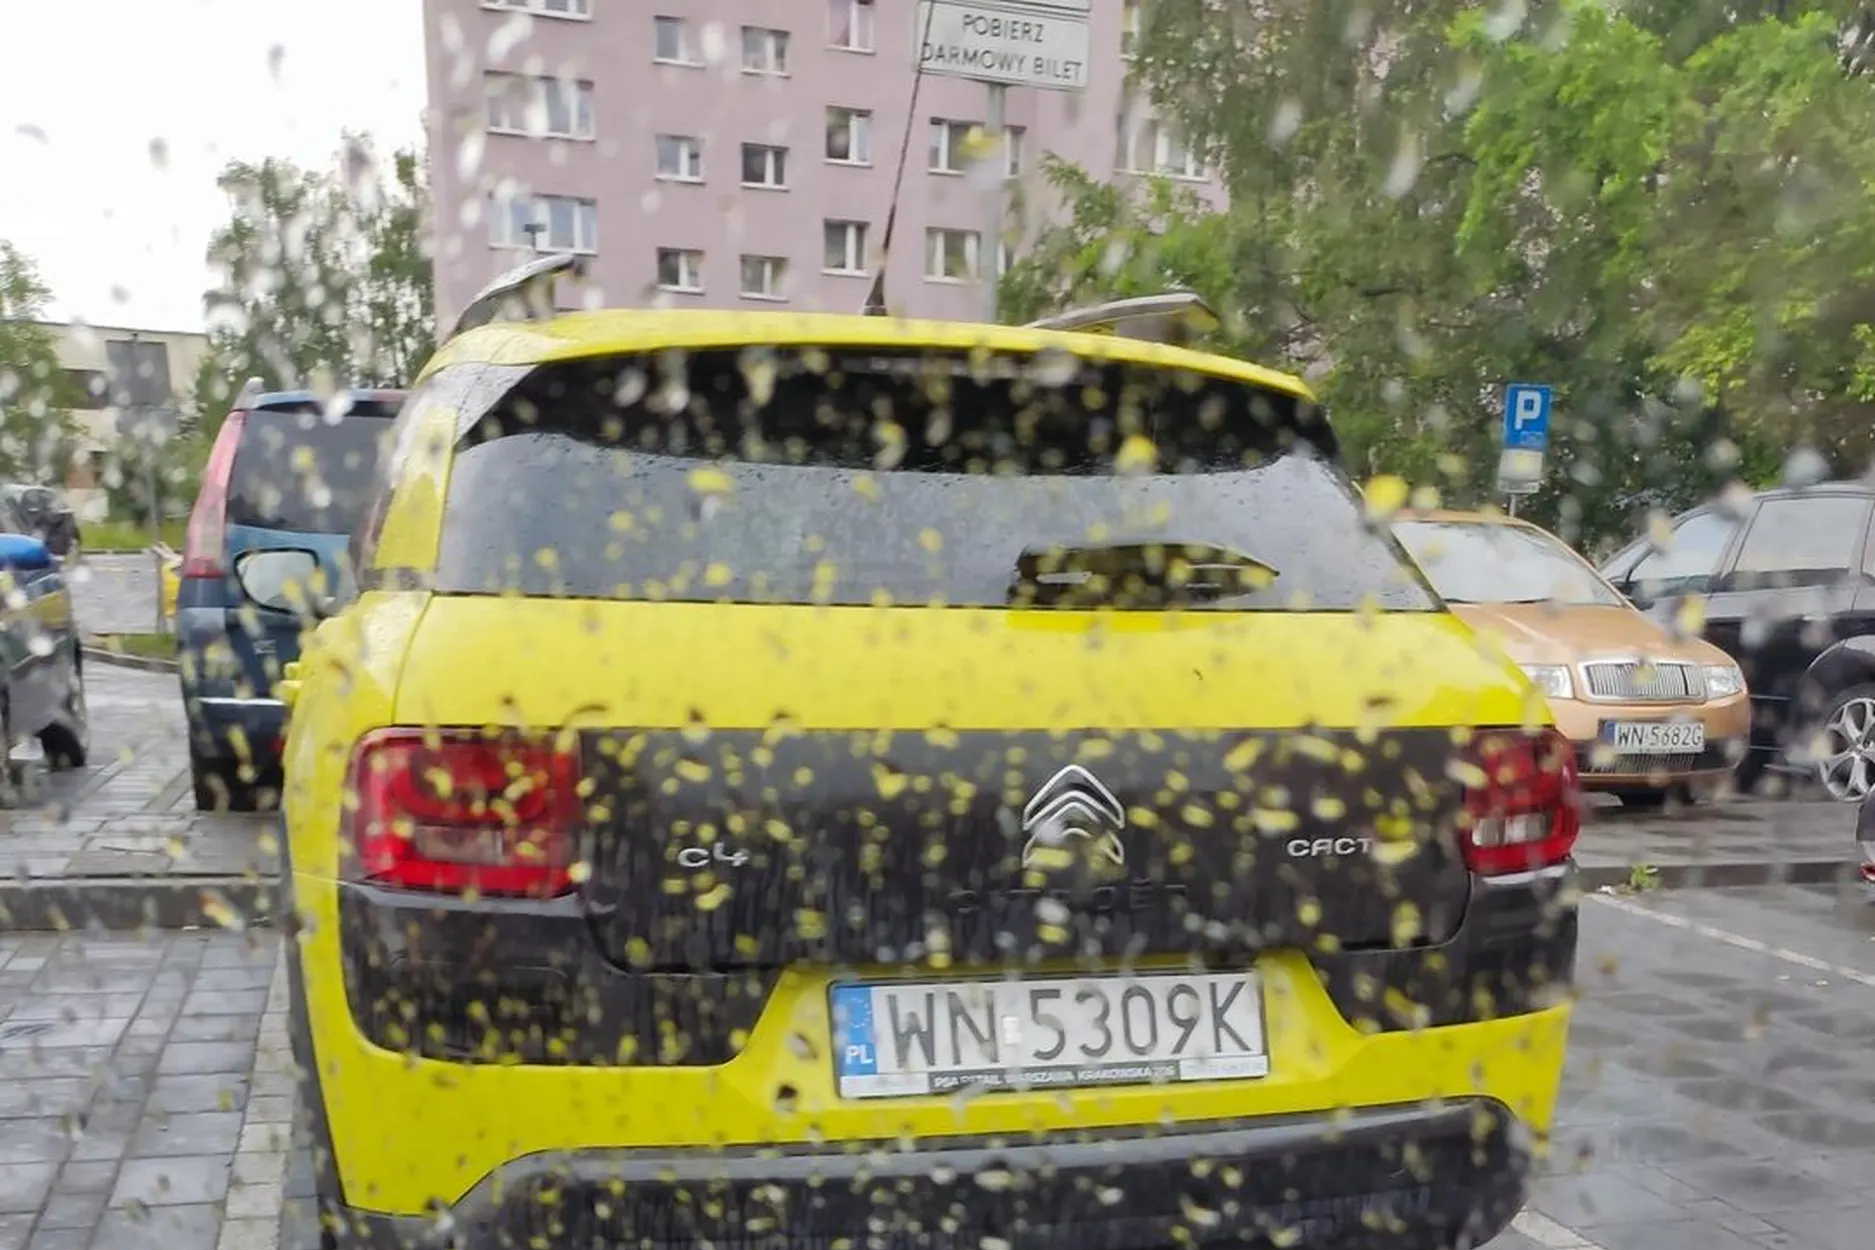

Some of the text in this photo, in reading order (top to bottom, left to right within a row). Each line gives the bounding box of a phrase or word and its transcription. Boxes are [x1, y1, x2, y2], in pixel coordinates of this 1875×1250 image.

[963, 13, 1044, 43] POBIERZ
[921, 42, 1082, 81] DARMOWY BILET
[1514, 390, 1542, 431] P
[1619, 725, 1645, 746] WN
[678, 841, 749, 868] C4
[1287, 837, 1405, 857] CACT
[886, 980, 1251, 1067] WN 5309K
[846, 1044, 874, 1065] PL
